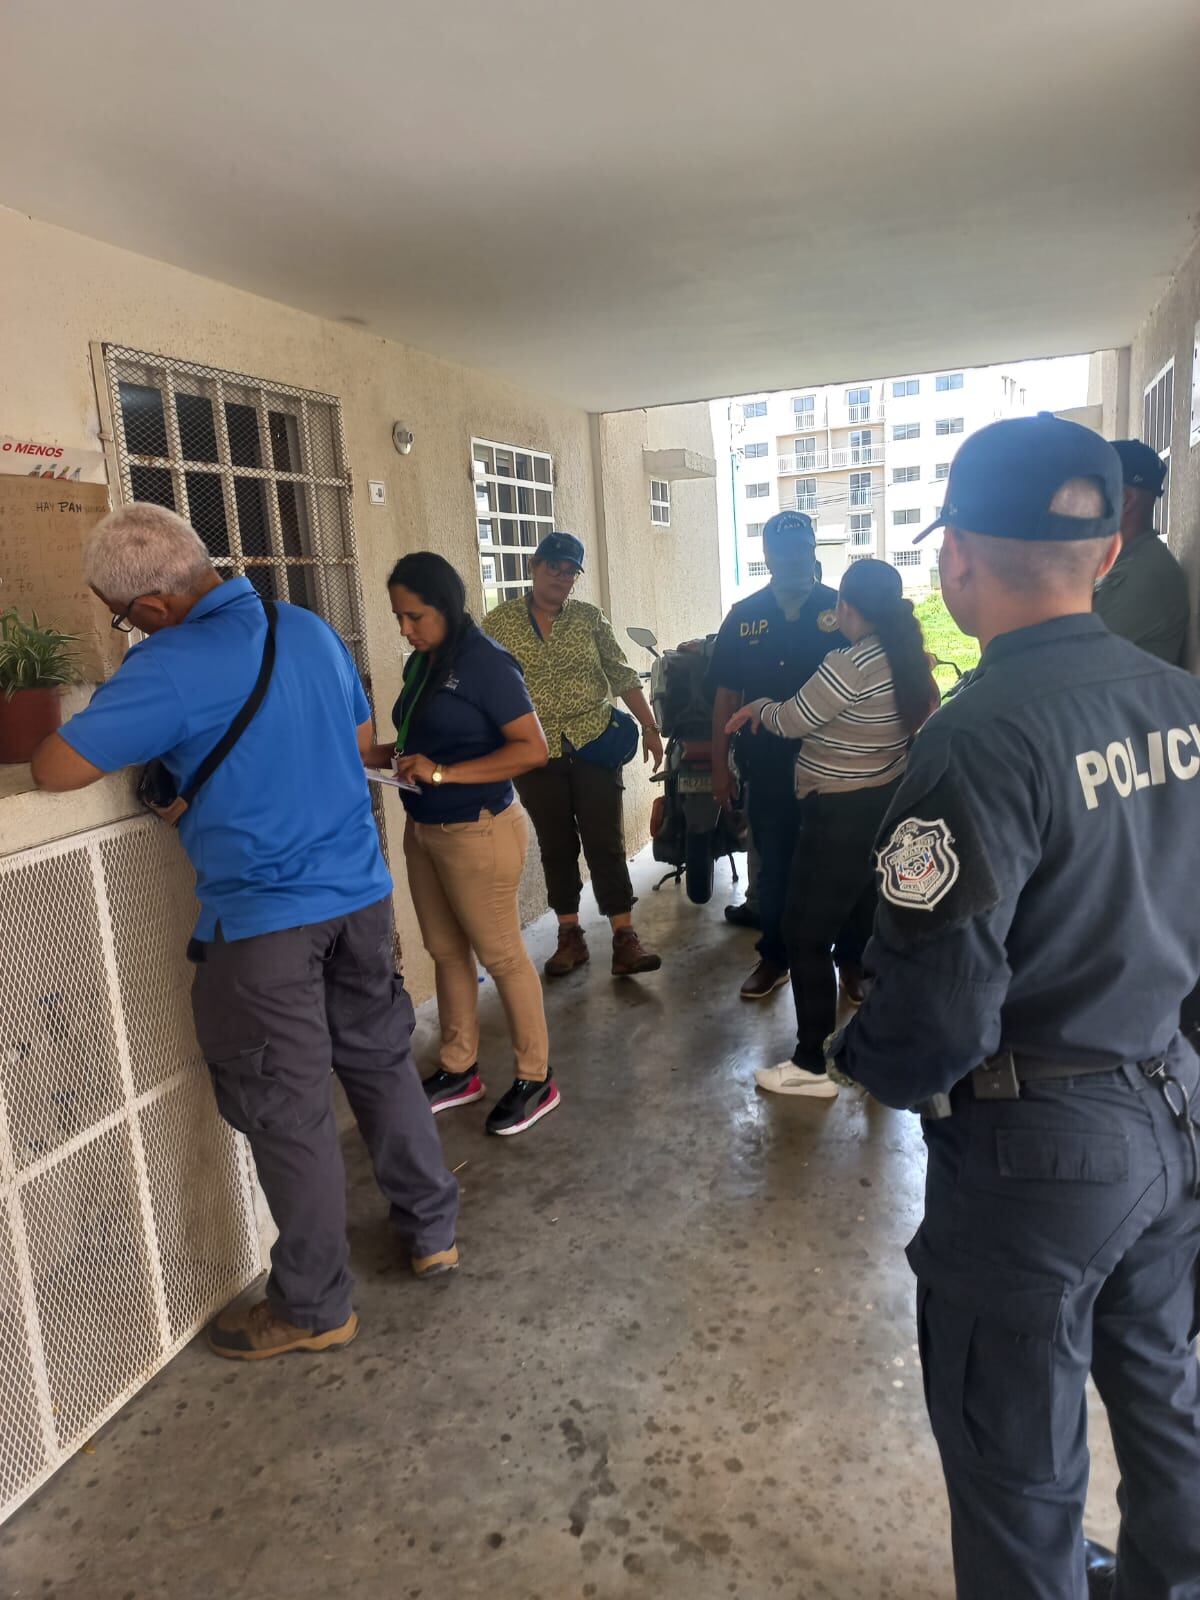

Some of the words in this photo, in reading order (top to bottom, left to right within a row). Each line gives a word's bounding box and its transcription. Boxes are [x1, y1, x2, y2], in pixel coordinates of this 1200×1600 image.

[14, 443, 64, 458] MENOS
[36, 501, 54, 512] HAY
[740, 619, 769, 637] D.I.P.
